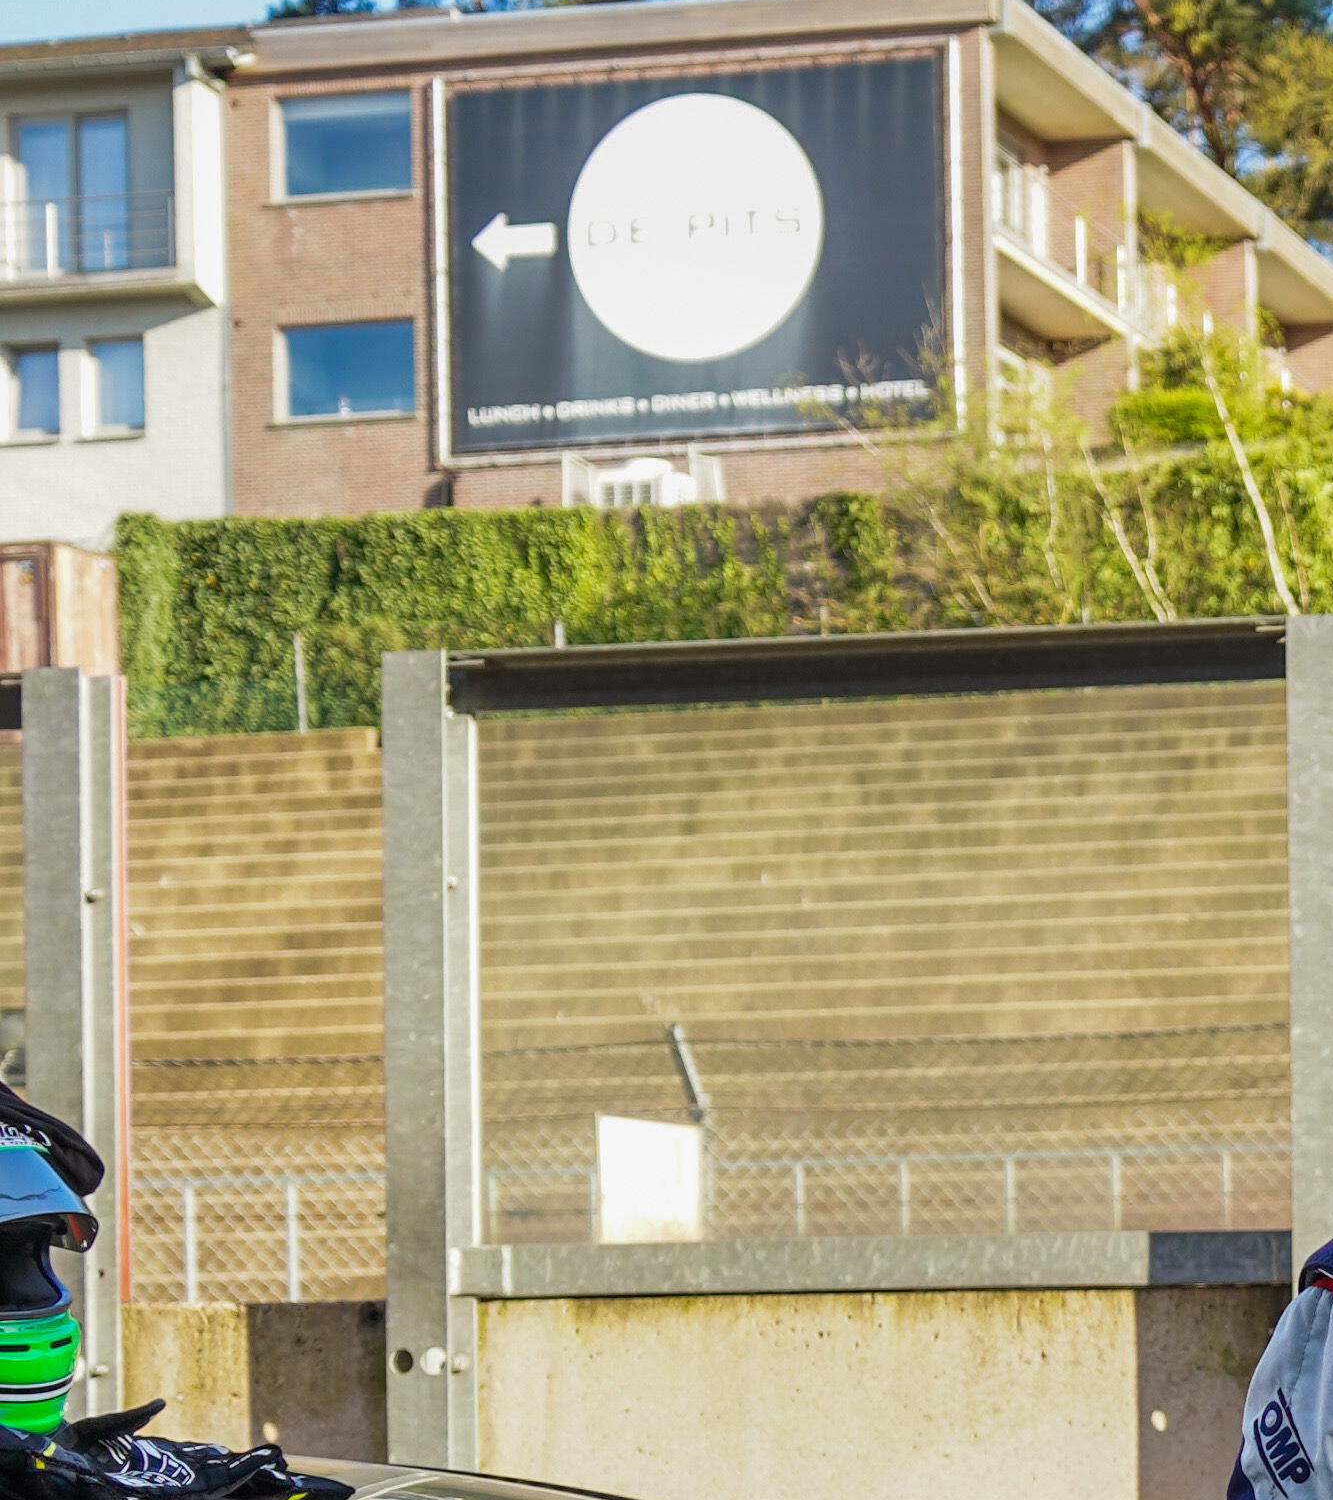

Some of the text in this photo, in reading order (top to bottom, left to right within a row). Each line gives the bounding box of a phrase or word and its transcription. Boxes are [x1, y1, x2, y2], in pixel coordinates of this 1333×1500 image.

[587, 207, 801, 247] DE PITS
[467, 377, 929, 428] LUNCH DRINKS DINER WELLNESS HOTEL
[1259, 1400, 1311, 1485] OMP
